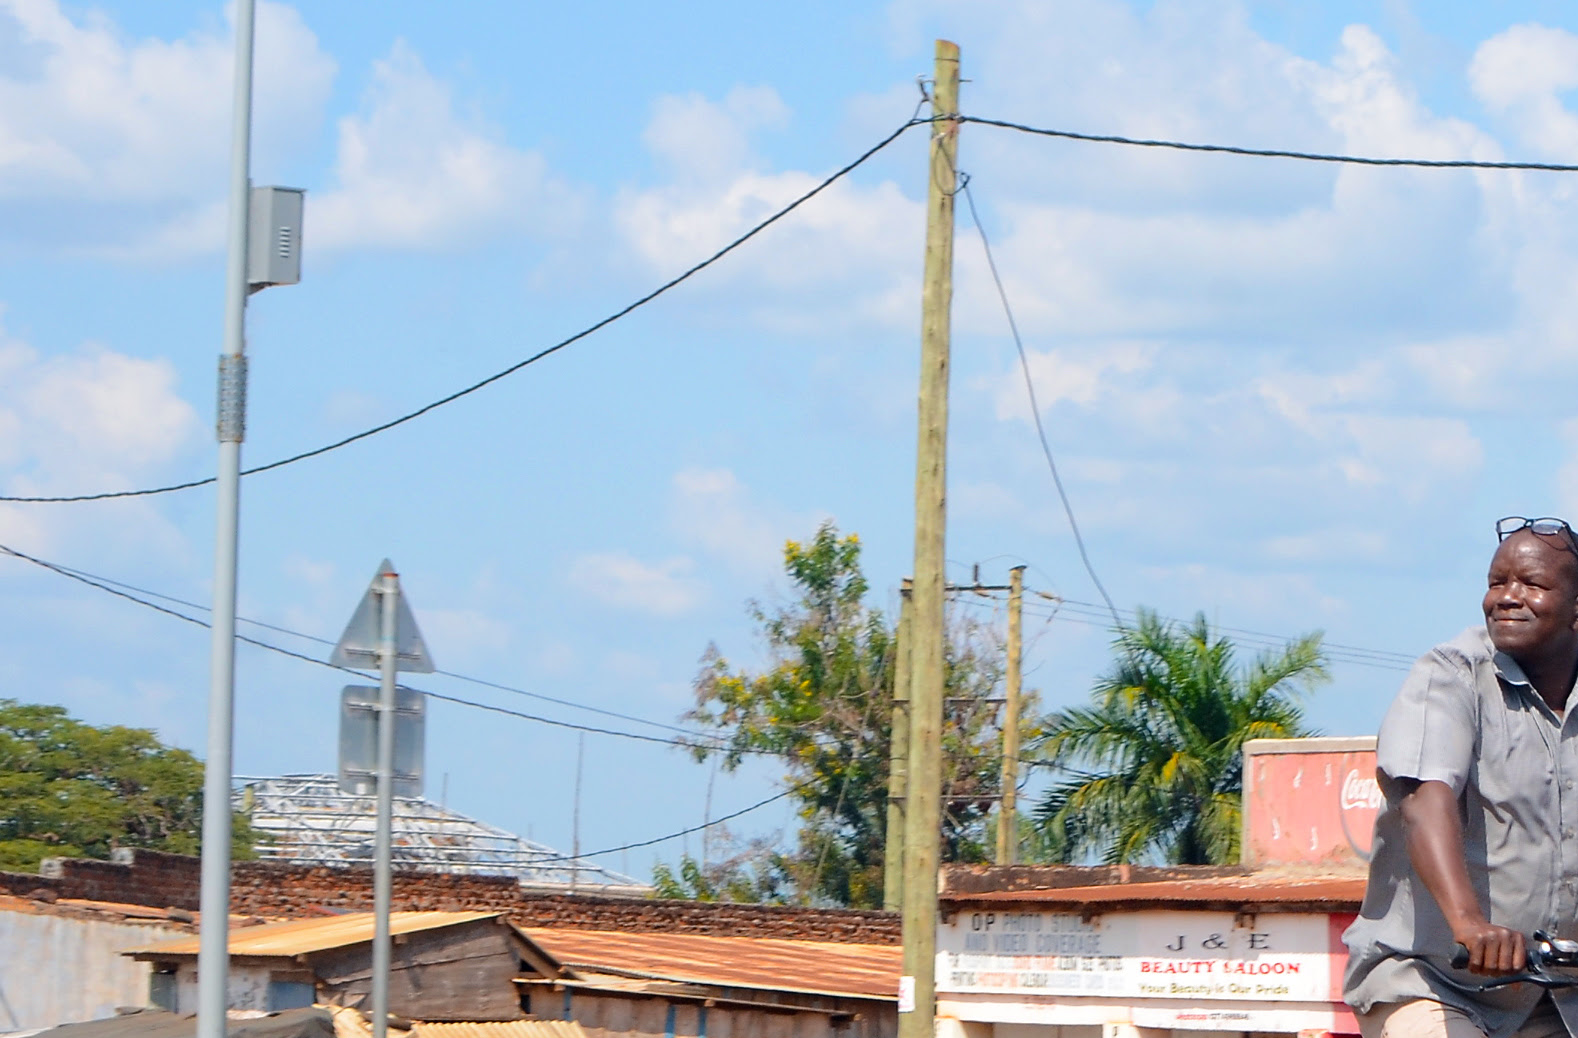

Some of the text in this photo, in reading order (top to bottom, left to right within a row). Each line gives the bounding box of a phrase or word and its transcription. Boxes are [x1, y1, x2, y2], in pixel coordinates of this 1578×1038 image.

[972, 913, 995, 931] OP
[1166, 933, 1270, 951] J & E
[1141, 961, 1302, 976] BEAUTY SALOON
[1170, 982, 1211, 995] Beauty
[1230, 982, 1252, 994] Our
[1256, 983, 1289, 995] Pride
